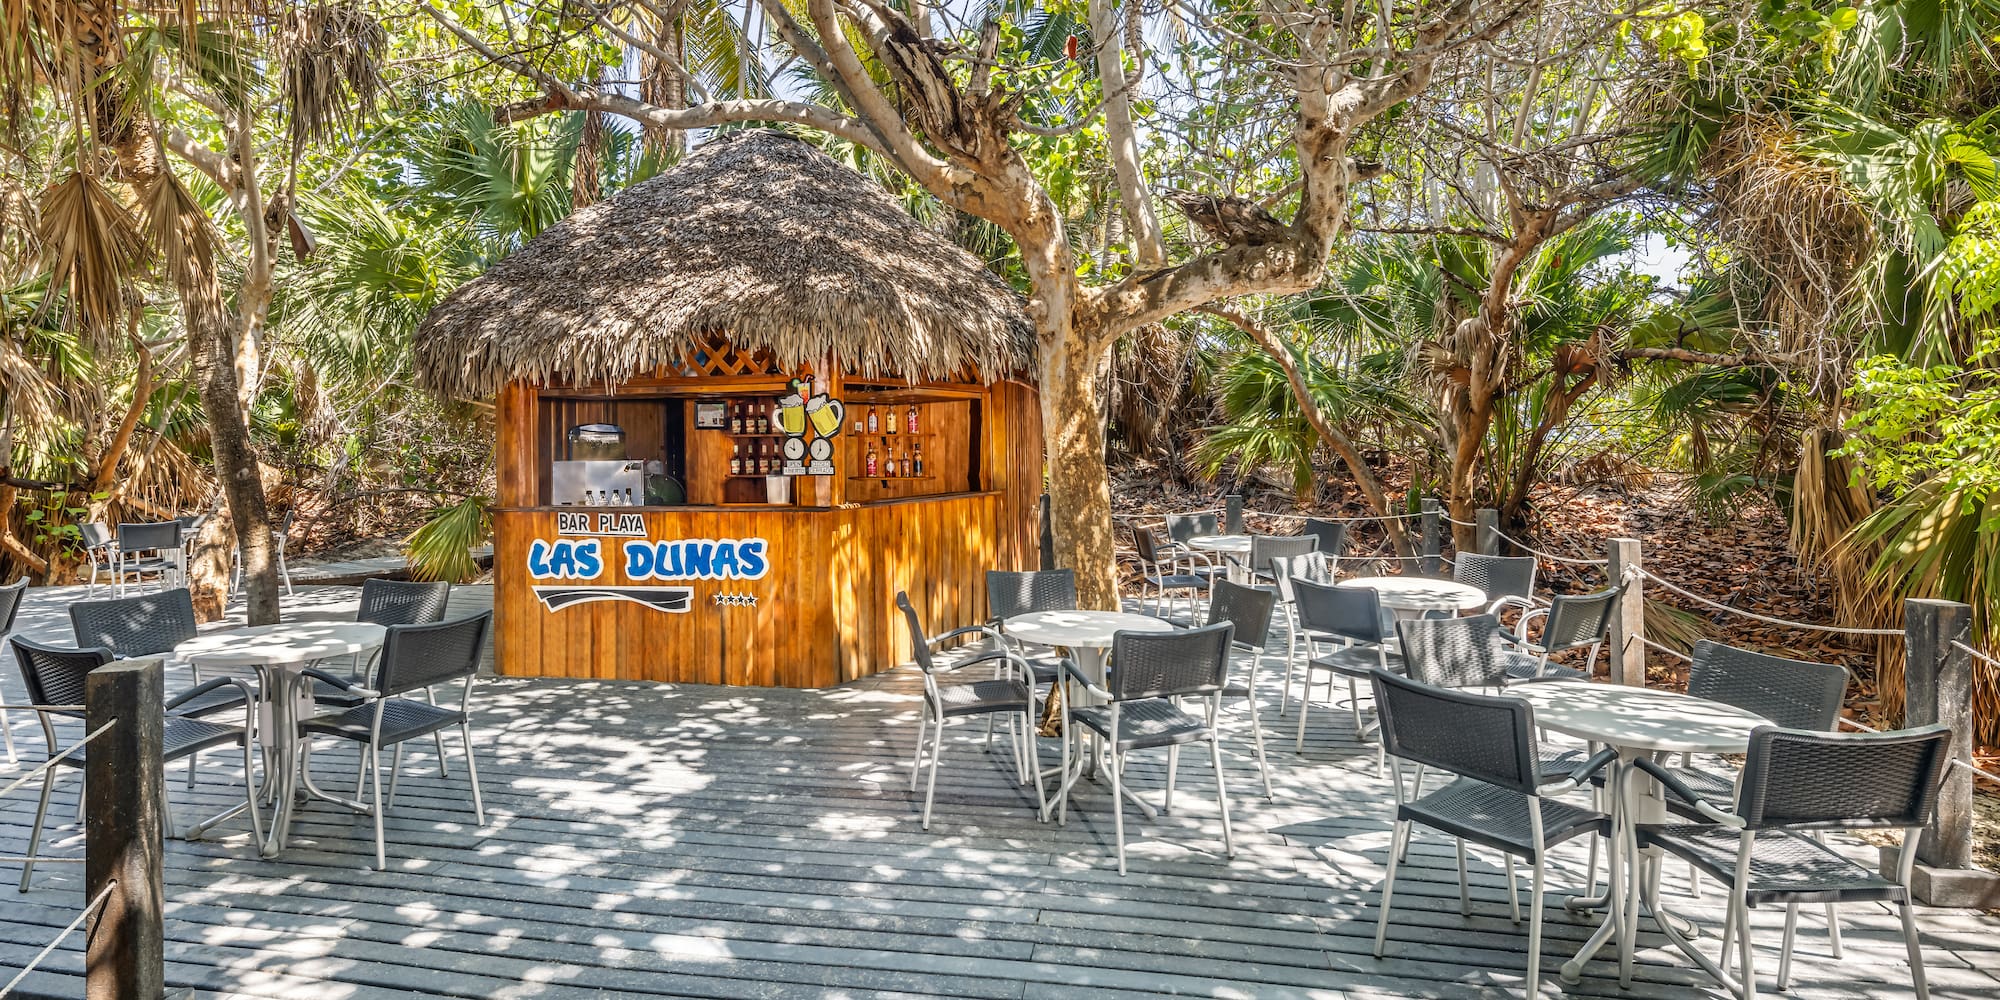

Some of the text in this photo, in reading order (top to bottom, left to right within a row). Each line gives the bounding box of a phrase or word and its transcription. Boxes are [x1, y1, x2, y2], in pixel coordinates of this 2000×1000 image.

[559, 514, 645, 532] BAR PLAYA
[529, 542, 765, 577] LAS DUNAS
